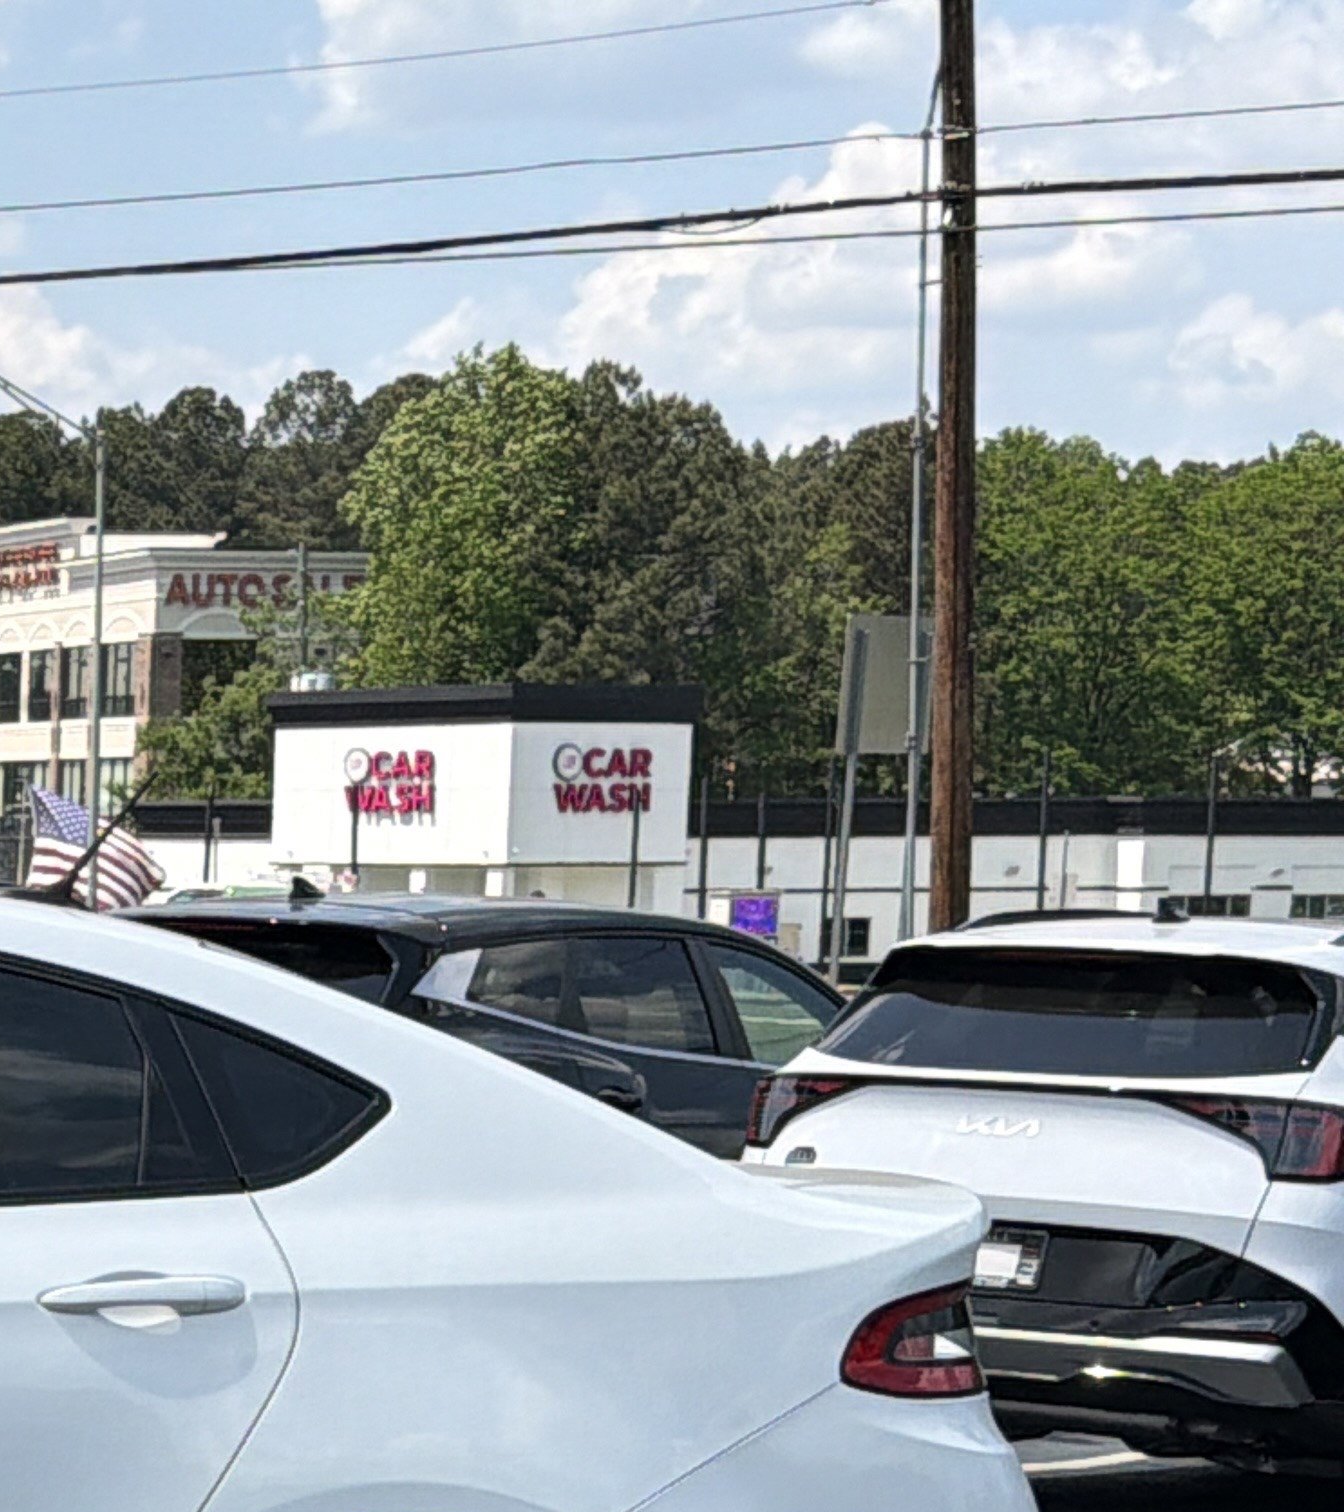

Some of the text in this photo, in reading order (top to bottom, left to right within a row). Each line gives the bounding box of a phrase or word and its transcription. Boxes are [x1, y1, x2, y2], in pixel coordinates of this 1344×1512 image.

[166, 573, 266, 609] AUTO
[372, 750, 434, 780] CAR
[583, 747, 653, 778] CAR
[344, 785, 435, 813] WASH
[554, 783, 651, 813] WASH
[956, 1115, 1040, 1137] KIA
